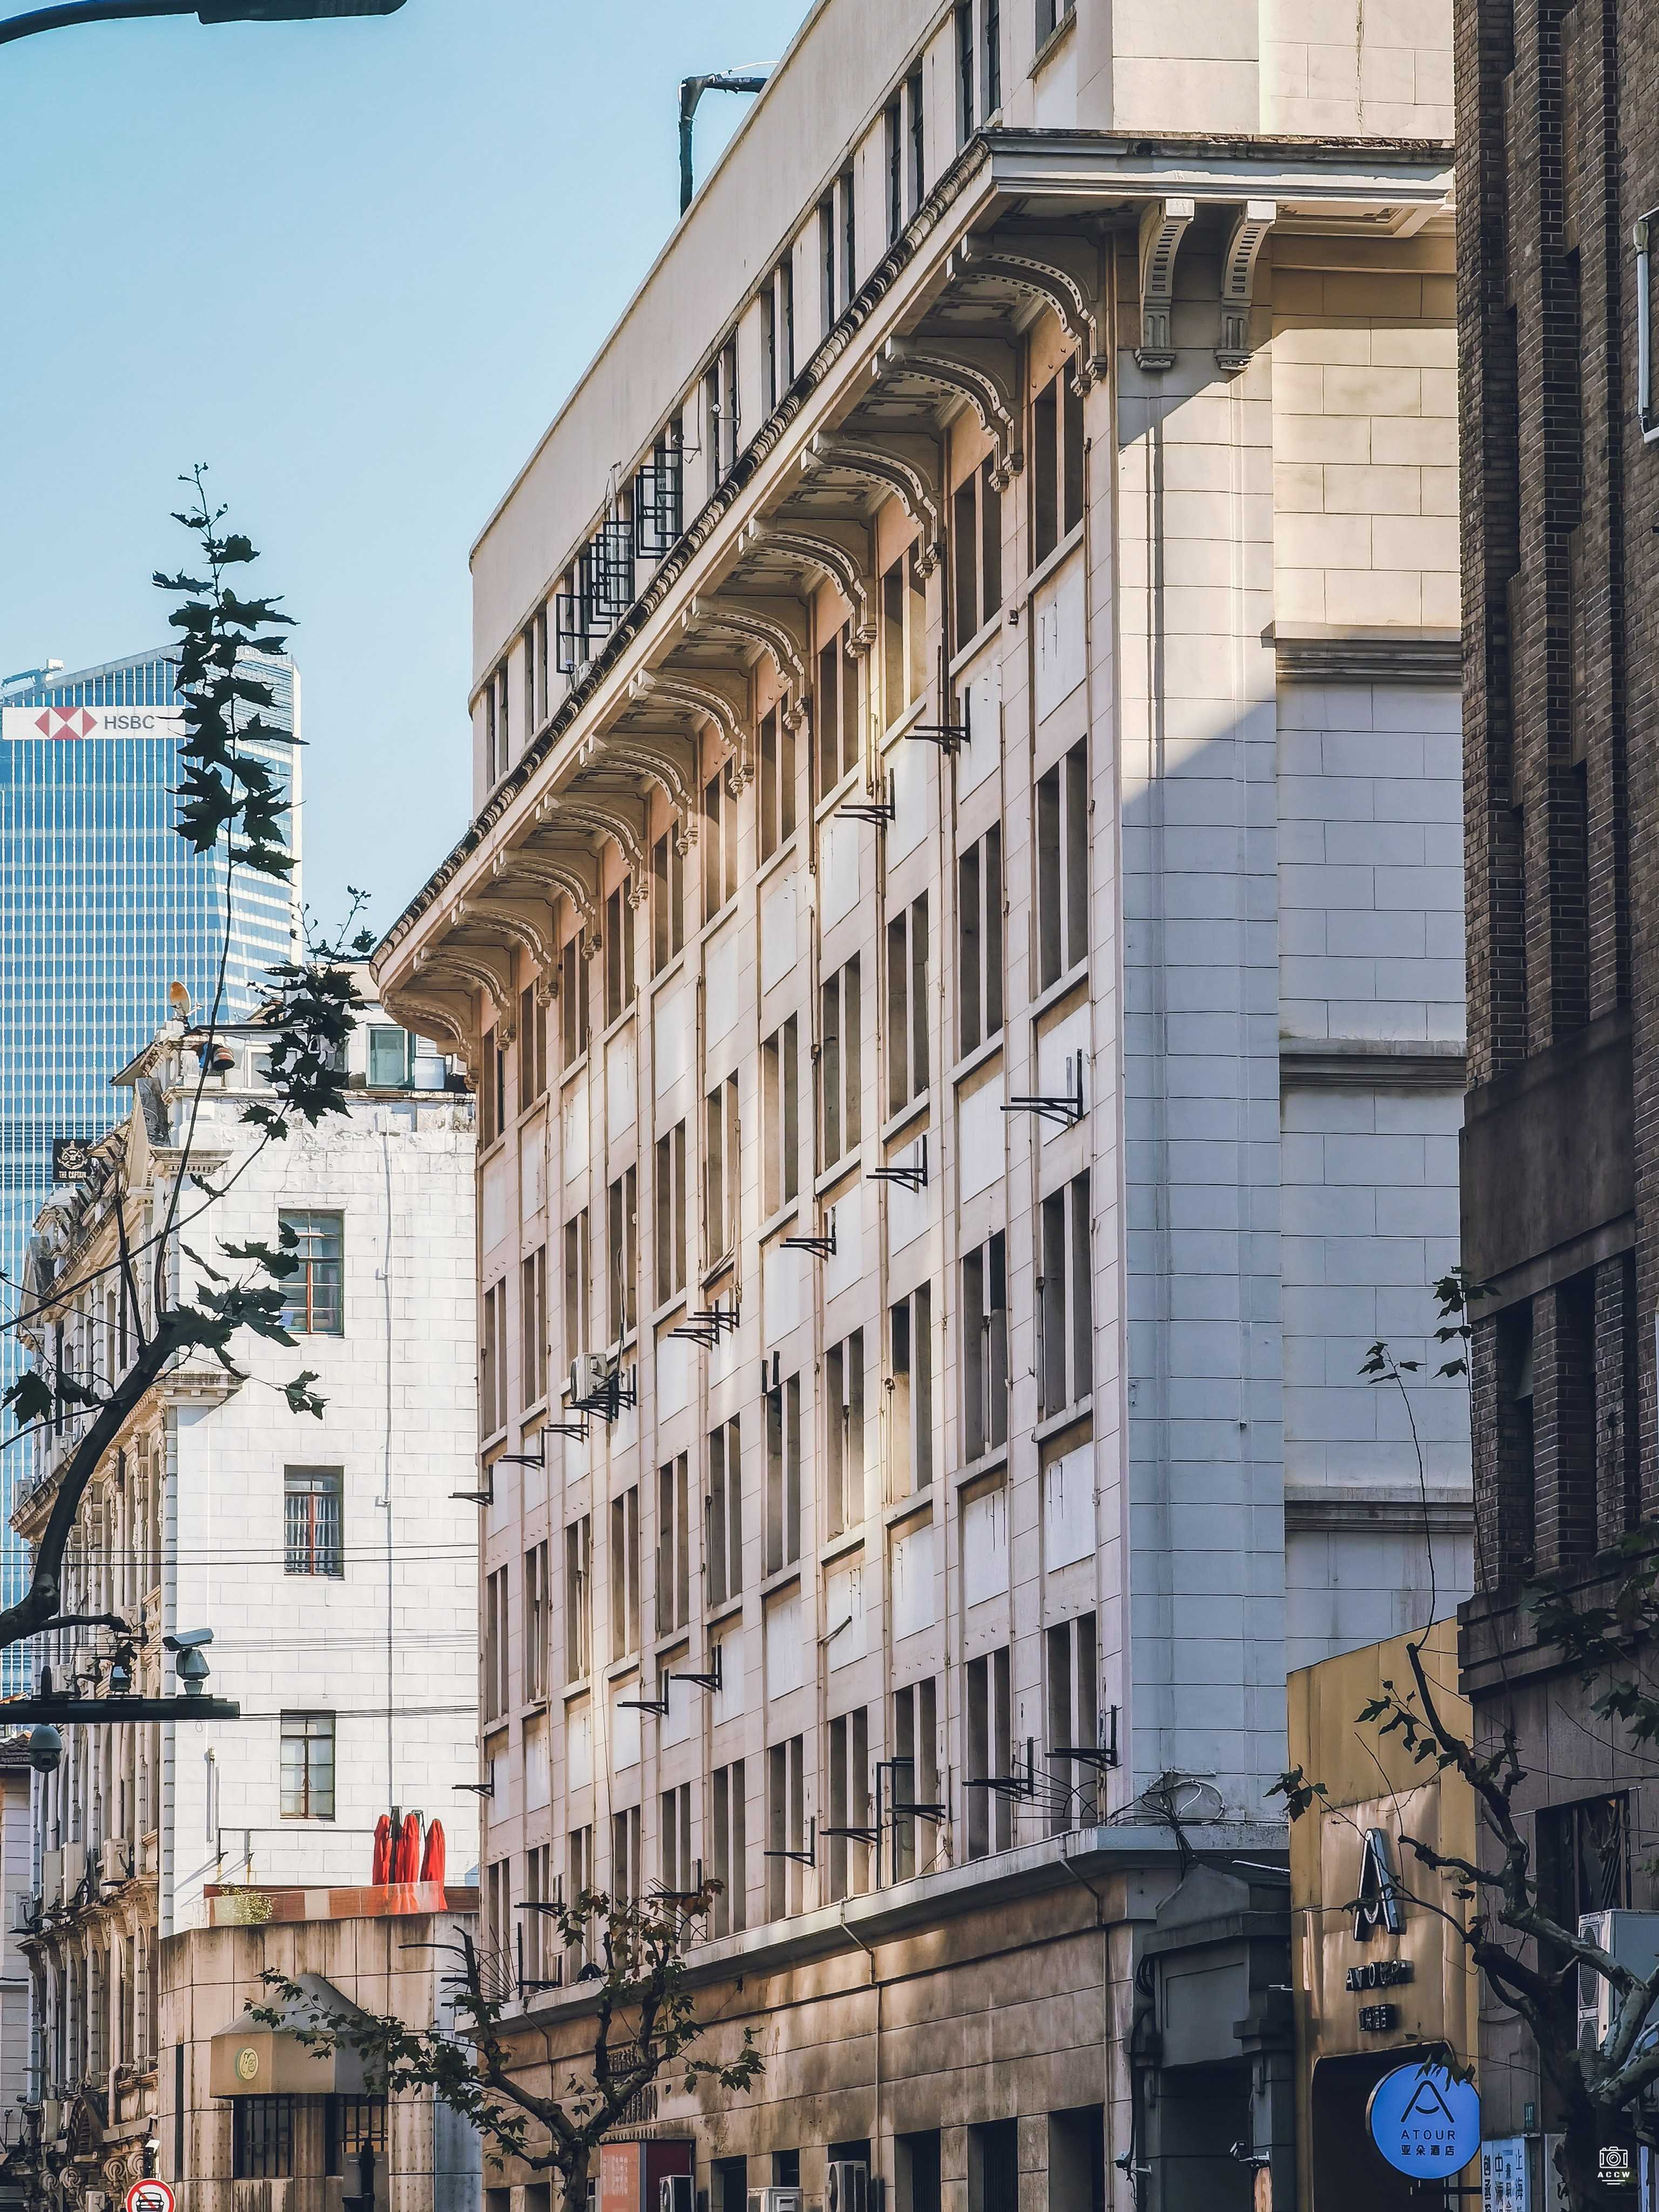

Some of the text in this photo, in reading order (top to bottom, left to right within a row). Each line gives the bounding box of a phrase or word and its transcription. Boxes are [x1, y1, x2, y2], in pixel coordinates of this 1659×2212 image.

[104, 715, 155, 730] HSBC
[1401, 2130, 1456, 2140] ATOUR
[1401, 2144, 1455, 2156] 亚朵酒店
